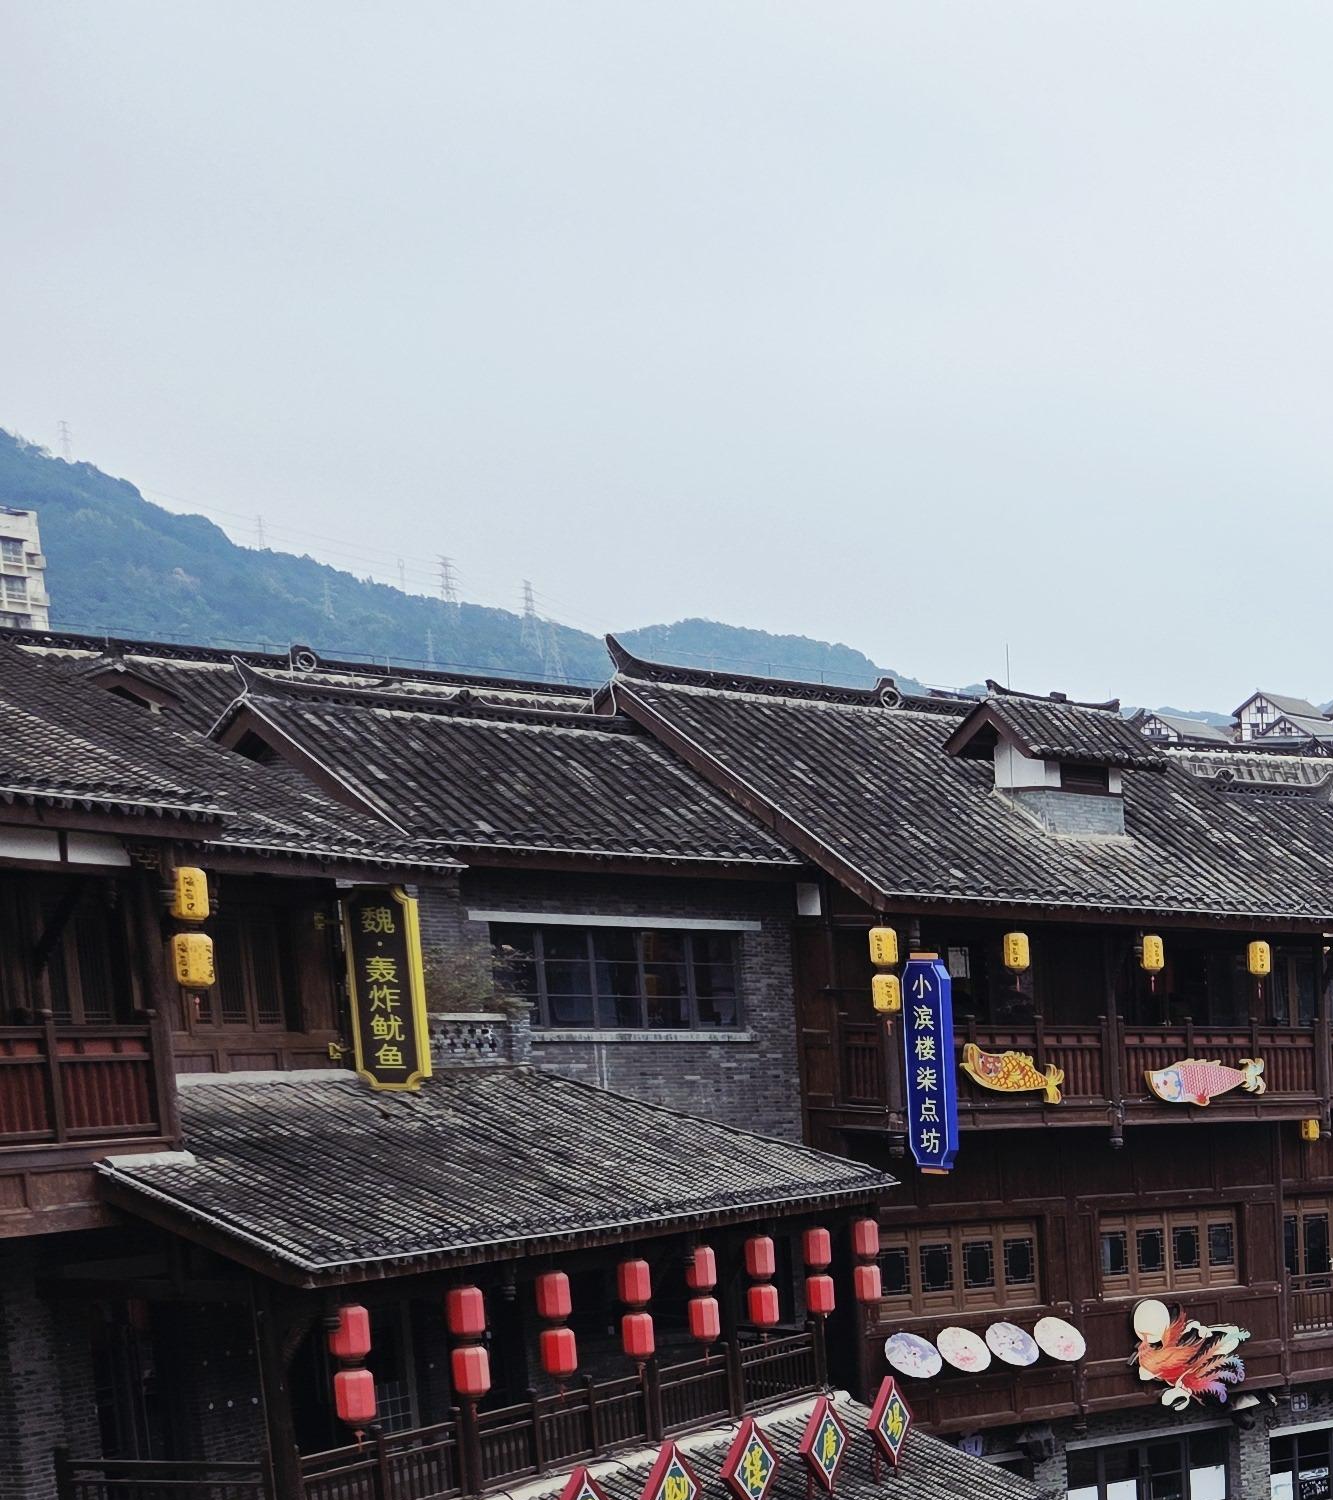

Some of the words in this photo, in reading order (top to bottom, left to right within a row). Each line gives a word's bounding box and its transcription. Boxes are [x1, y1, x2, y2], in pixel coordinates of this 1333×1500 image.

[360, 906, 407, 1070] 魏·轰炸鱿鱼
[912, 973, 941, 1154] 小滨楼柒点坊
